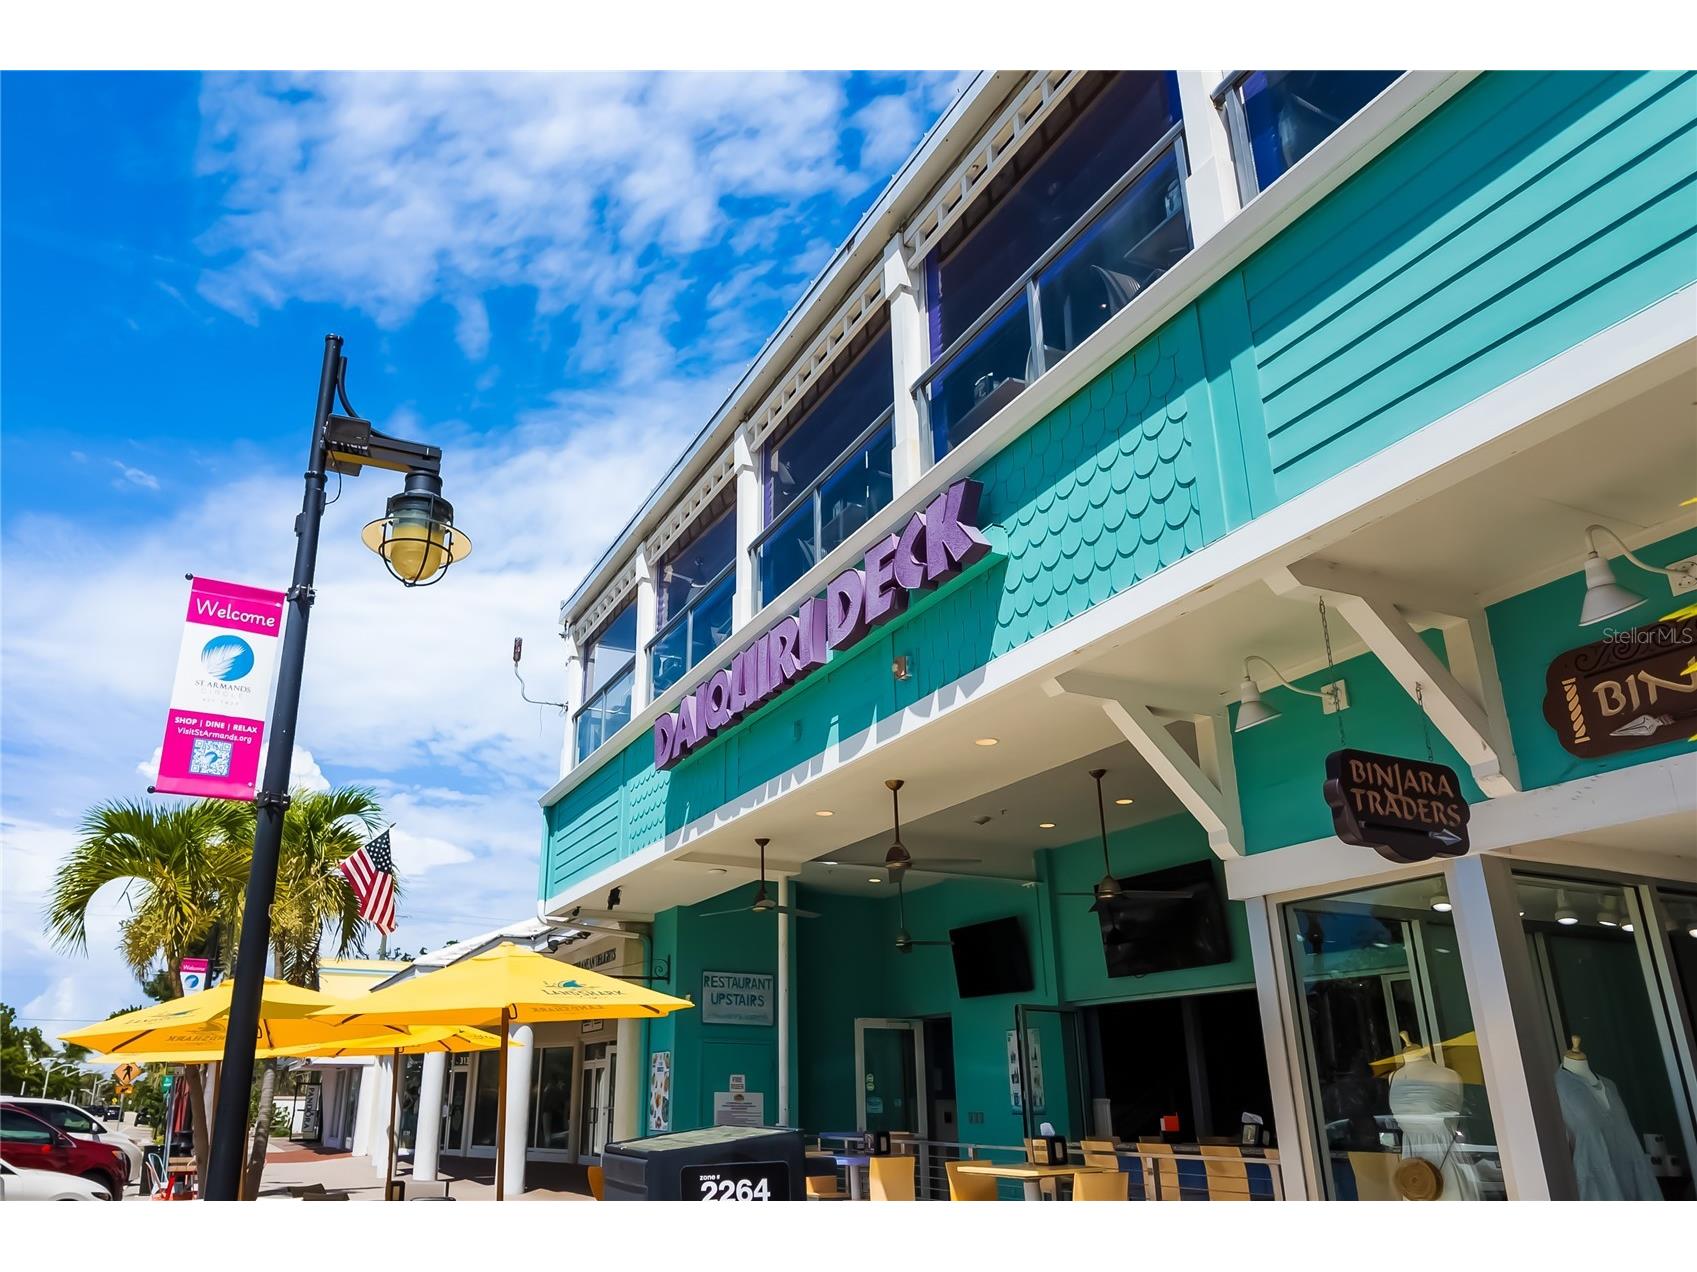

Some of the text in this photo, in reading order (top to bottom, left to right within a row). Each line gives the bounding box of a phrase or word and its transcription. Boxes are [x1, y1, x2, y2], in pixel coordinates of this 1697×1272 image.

[196, 598, 275, 627] Welcome
[654, 478, 992, 771] DAIQUIRI DECK
[207, 681, 253, 693] ARMANDS
[174, 716, 198, 726] SHOP
[205, 720, 225, 729] DINE
[233, 724, 258, 734] RELAX
[177, 726, 252, 744] VisitStArmands.org
[1349, 759, 1455, 798] BINJARA
[1350, 787, 1461, 827] TRADERS
[703, 975, 773, 991] RESTAURANT
[710, 992, 766, 1008] UPSTAIRS
[304, 1087, 316, 1129] PANDORA
[700, 1178, 771, 1201] 2264
